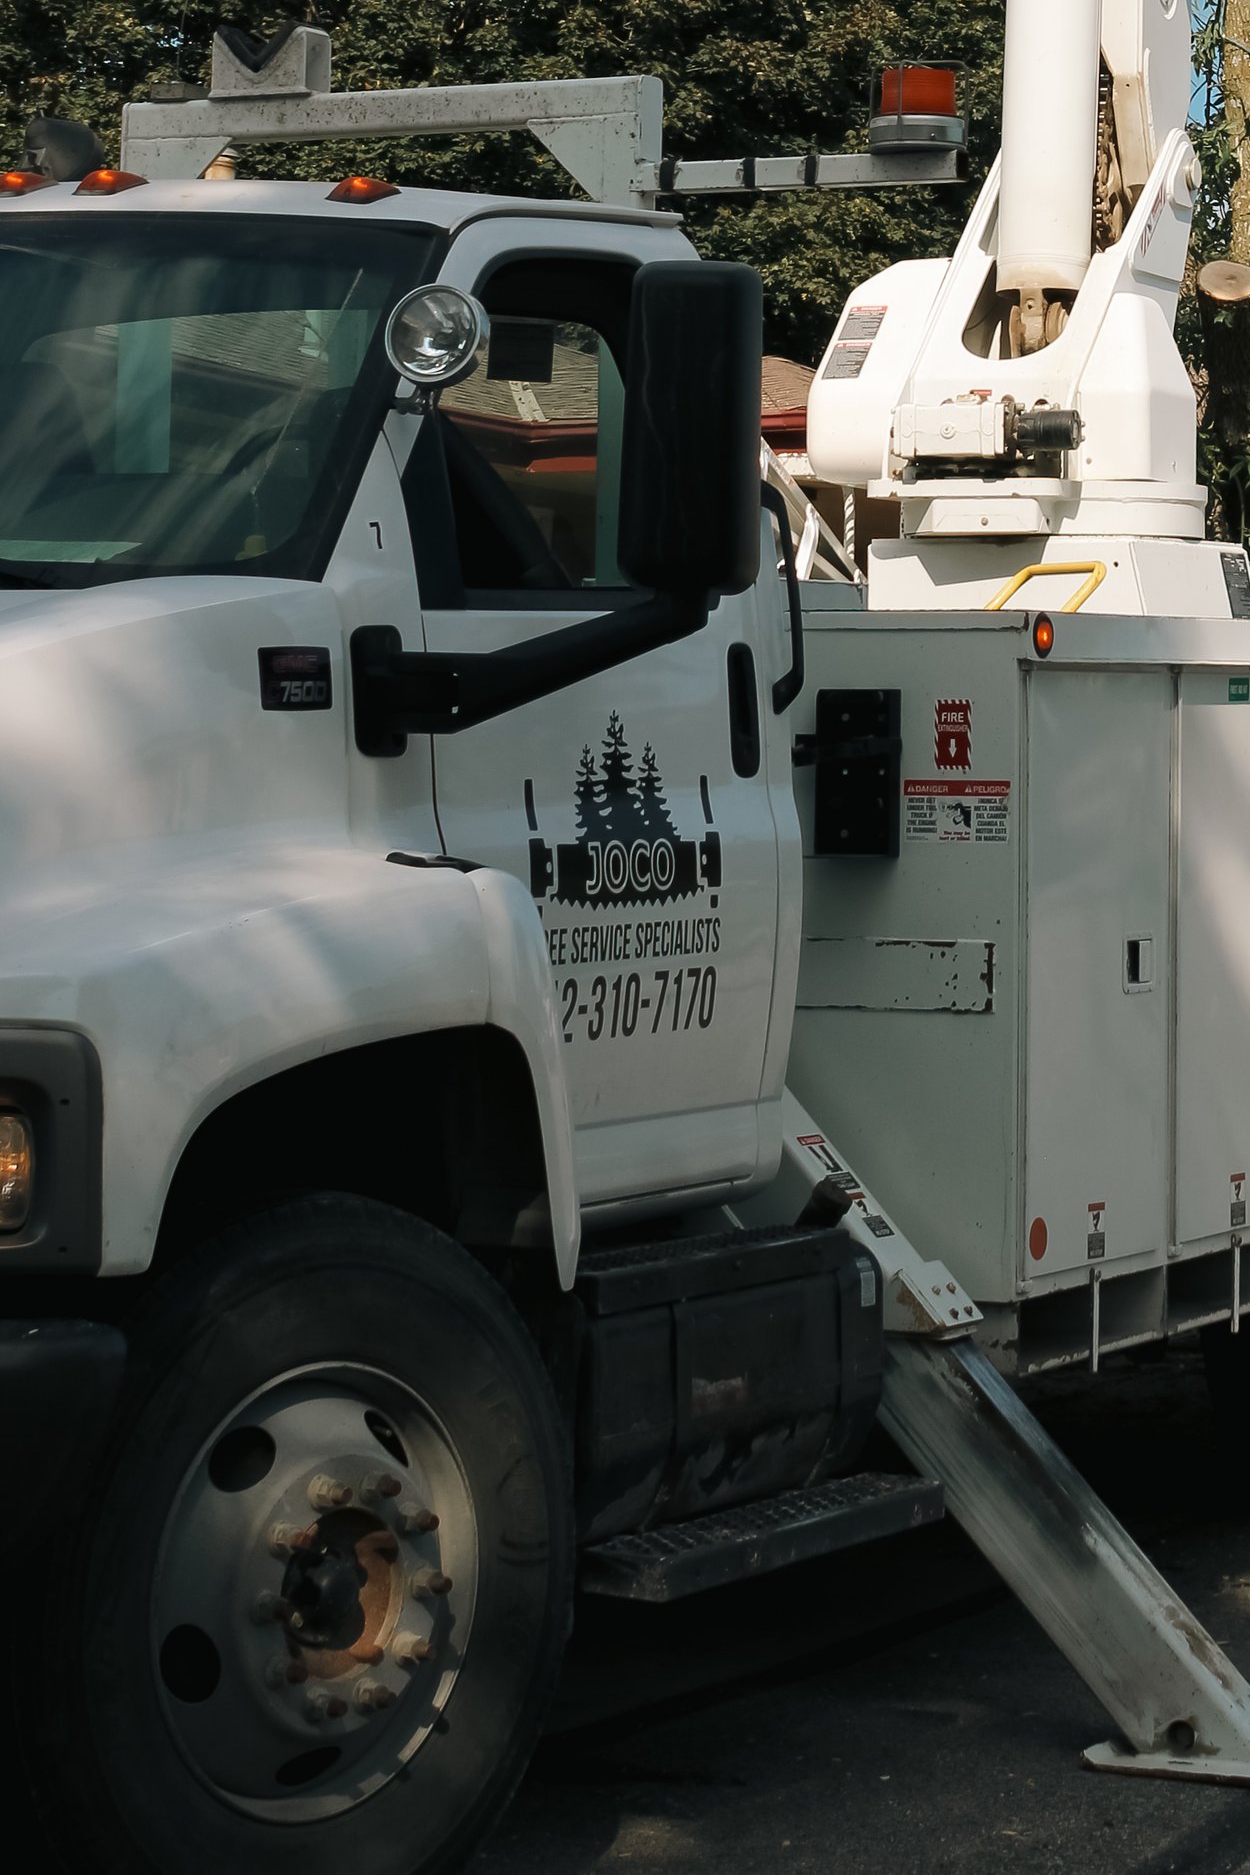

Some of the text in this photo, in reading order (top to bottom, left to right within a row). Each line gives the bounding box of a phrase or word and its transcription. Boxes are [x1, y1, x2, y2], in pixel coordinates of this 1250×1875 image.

[369, 521, 383, 550] 7
[266, 680, 328, 702] C7500
[941, 712, 964, 723] FIRE
[915, 785, 1007, 794] DANGER PELIGRO
[586, 838, 676, 896] JOCO
[571, 923, 633, 964] SERVICE
[635, 917, 721, 959] SPECIALISTS
[555, 966, 717, 1043] 2-310-7170
